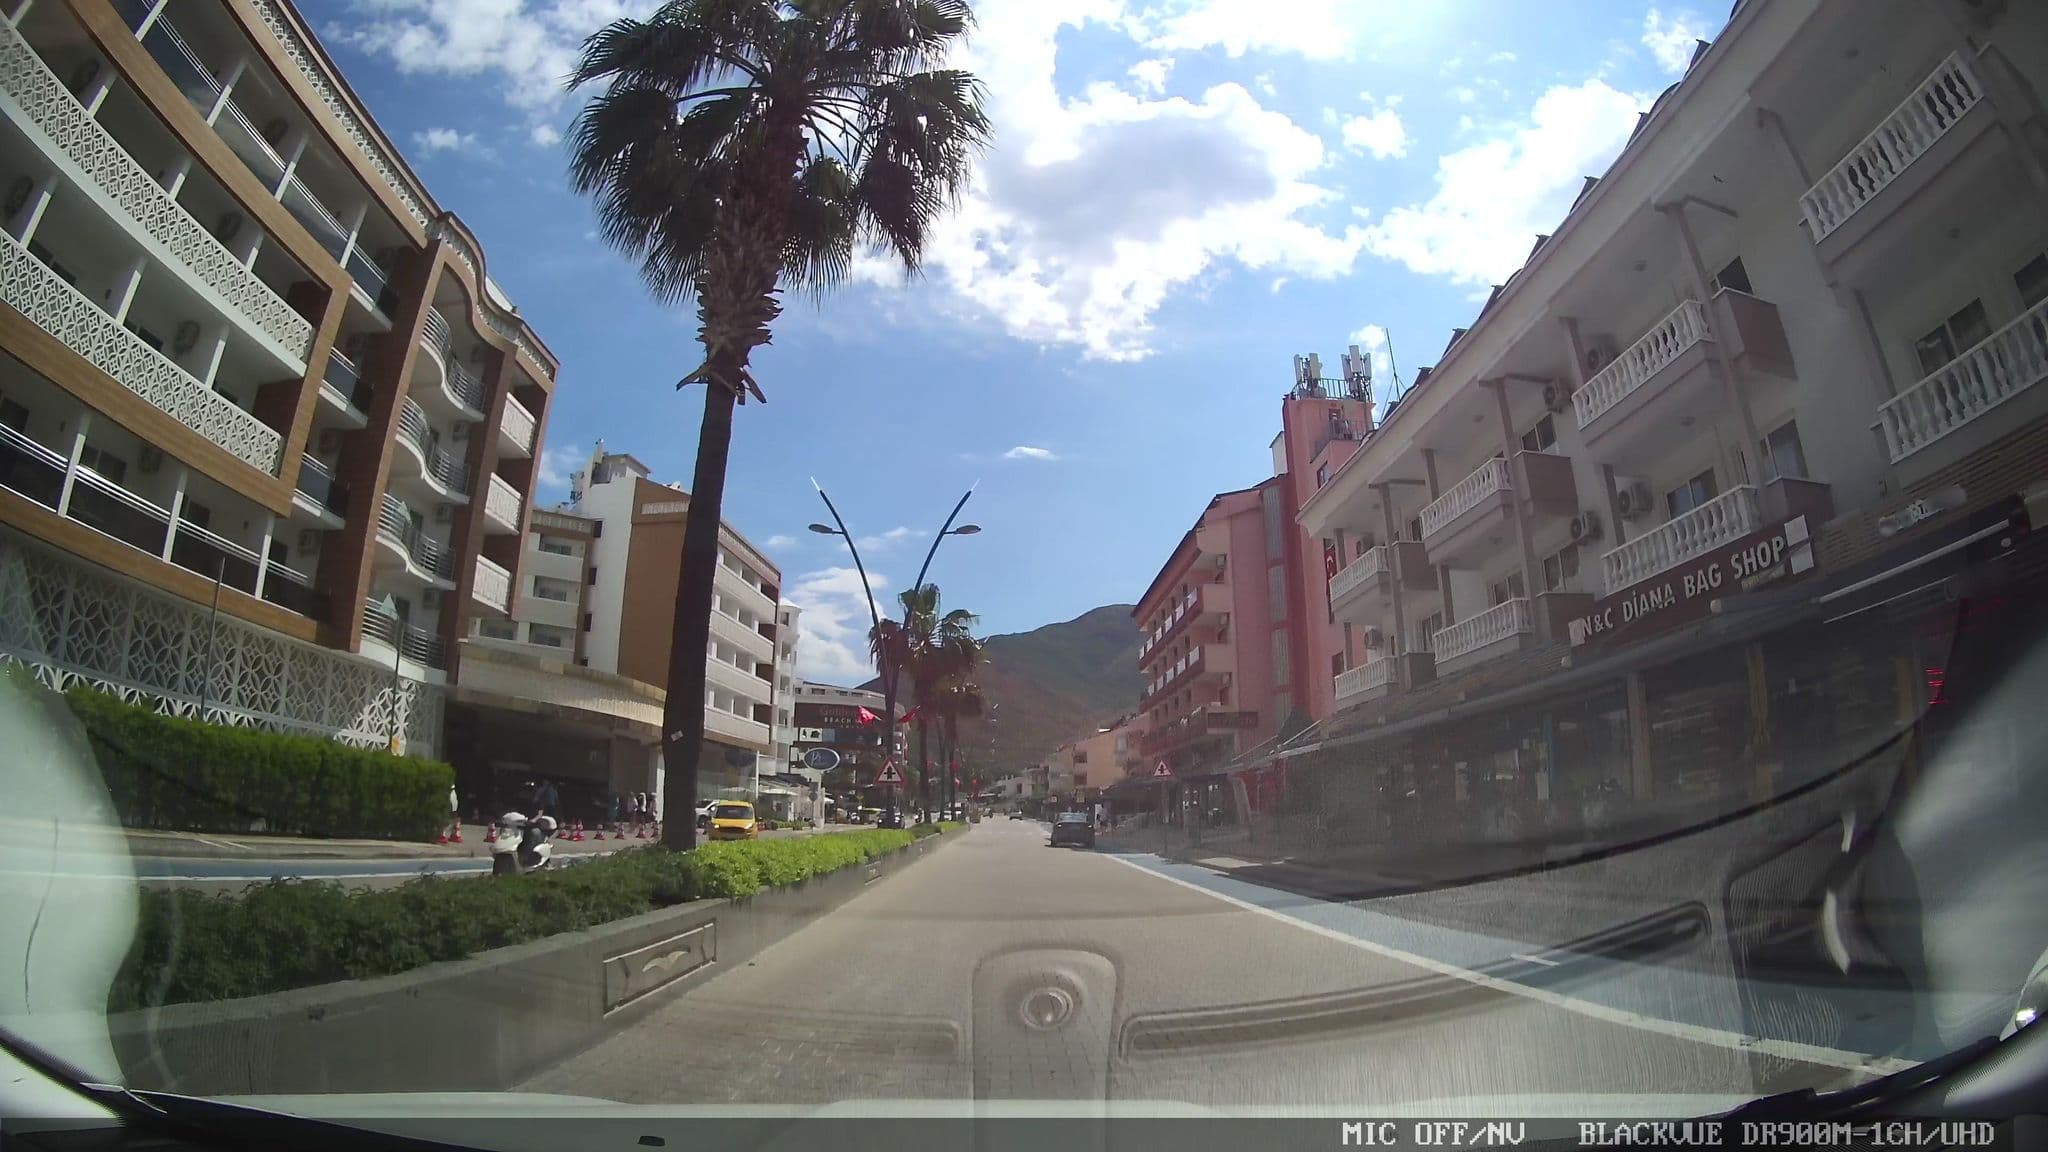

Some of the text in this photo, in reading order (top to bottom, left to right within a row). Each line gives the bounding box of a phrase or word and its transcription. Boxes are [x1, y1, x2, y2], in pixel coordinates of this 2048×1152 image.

[1582, 607, 1614, 637] N&C
[1683, 562, 1722, 599] BAG
[1731, 536, 1786, 579] SHOP
